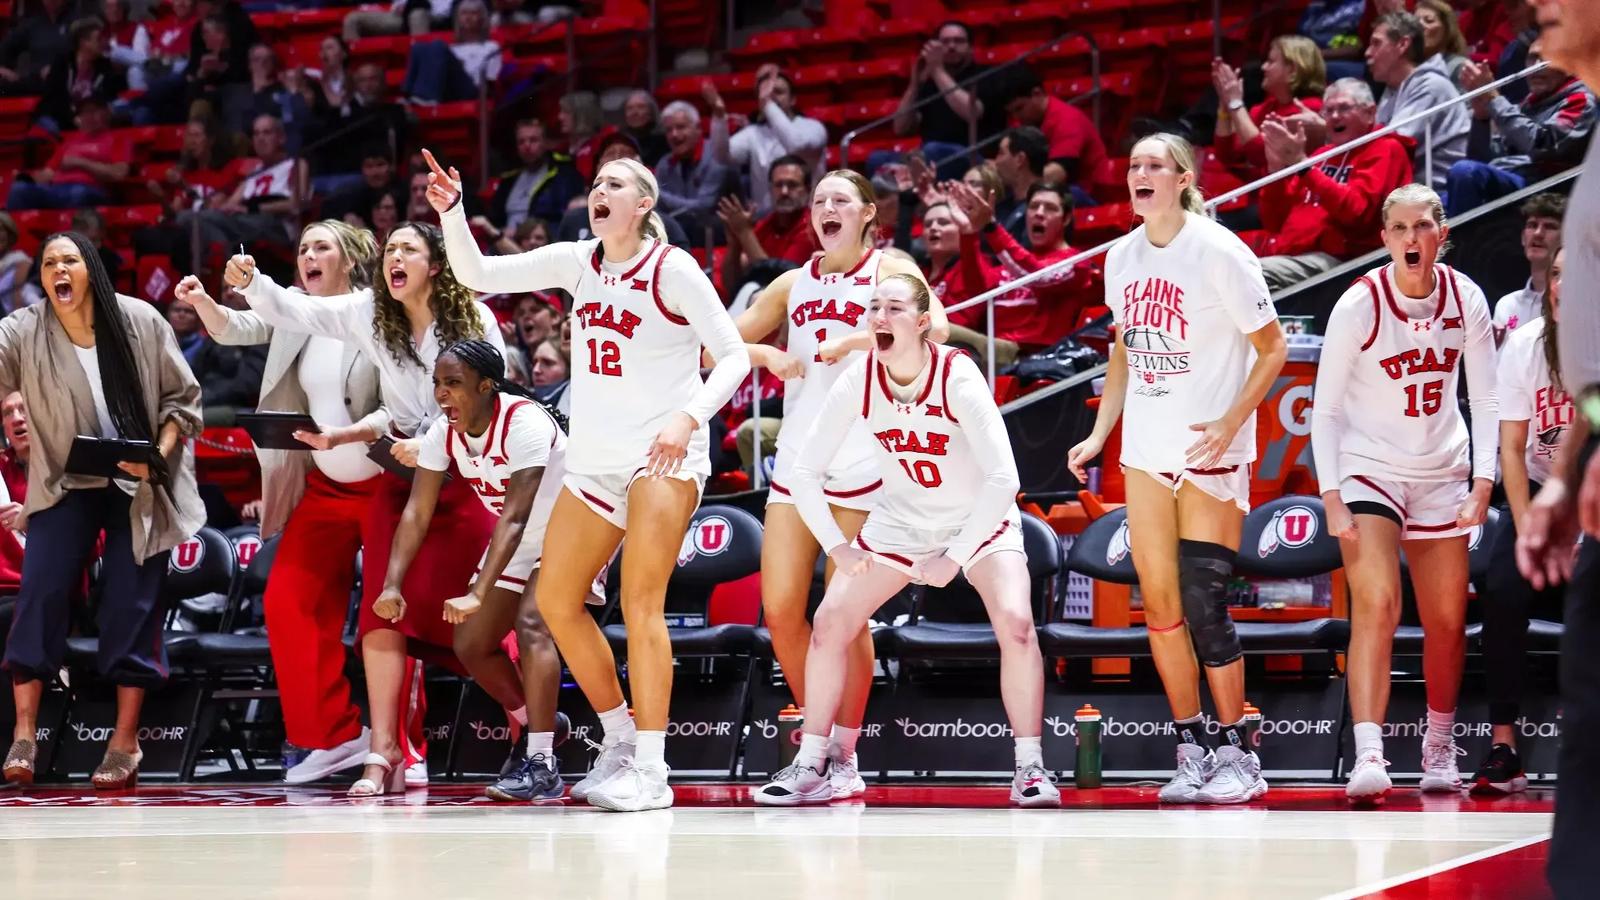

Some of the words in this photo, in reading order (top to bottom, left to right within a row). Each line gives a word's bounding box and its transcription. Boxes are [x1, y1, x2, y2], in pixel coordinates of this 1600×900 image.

[1123, 277, 1184, 315] ELAINE
[791, 299, 866, 328] UTAH
[587, 338, 622, 377] 12
[1143, 355, 1189, 371] WINS
[1403, 379, 1444, 417] 15
[701, 524, 726, 550] U
[1284, 515, 1310, 542] U
[177, 542, 200, 568] U
[903, 717, 1014, 737] bambooH
